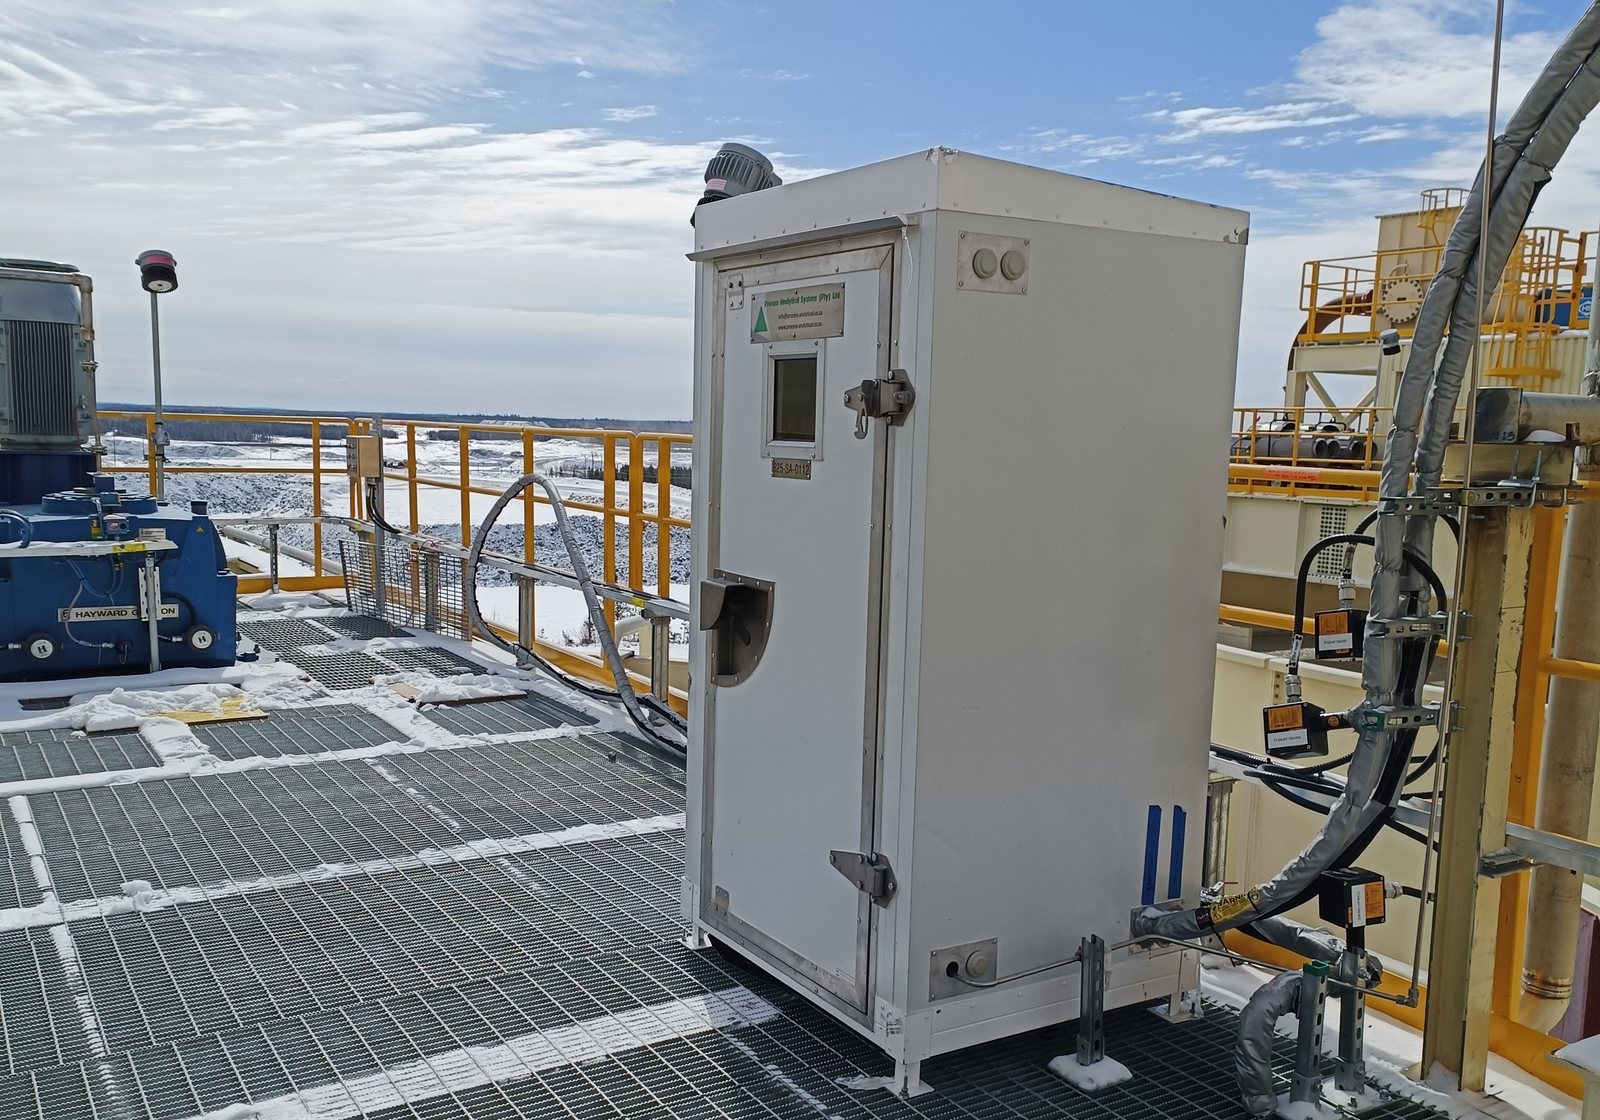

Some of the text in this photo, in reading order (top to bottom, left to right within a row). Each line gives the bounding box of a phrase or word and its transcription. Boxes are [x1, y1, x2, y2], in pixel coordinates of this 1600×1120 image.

[801, 295, 818, 304] Systems
[819, 292, 831, 302] (Pty)
[832, 291, 840, 299] Ltd
[75, 607, 175, 618] HAYWARD GON
